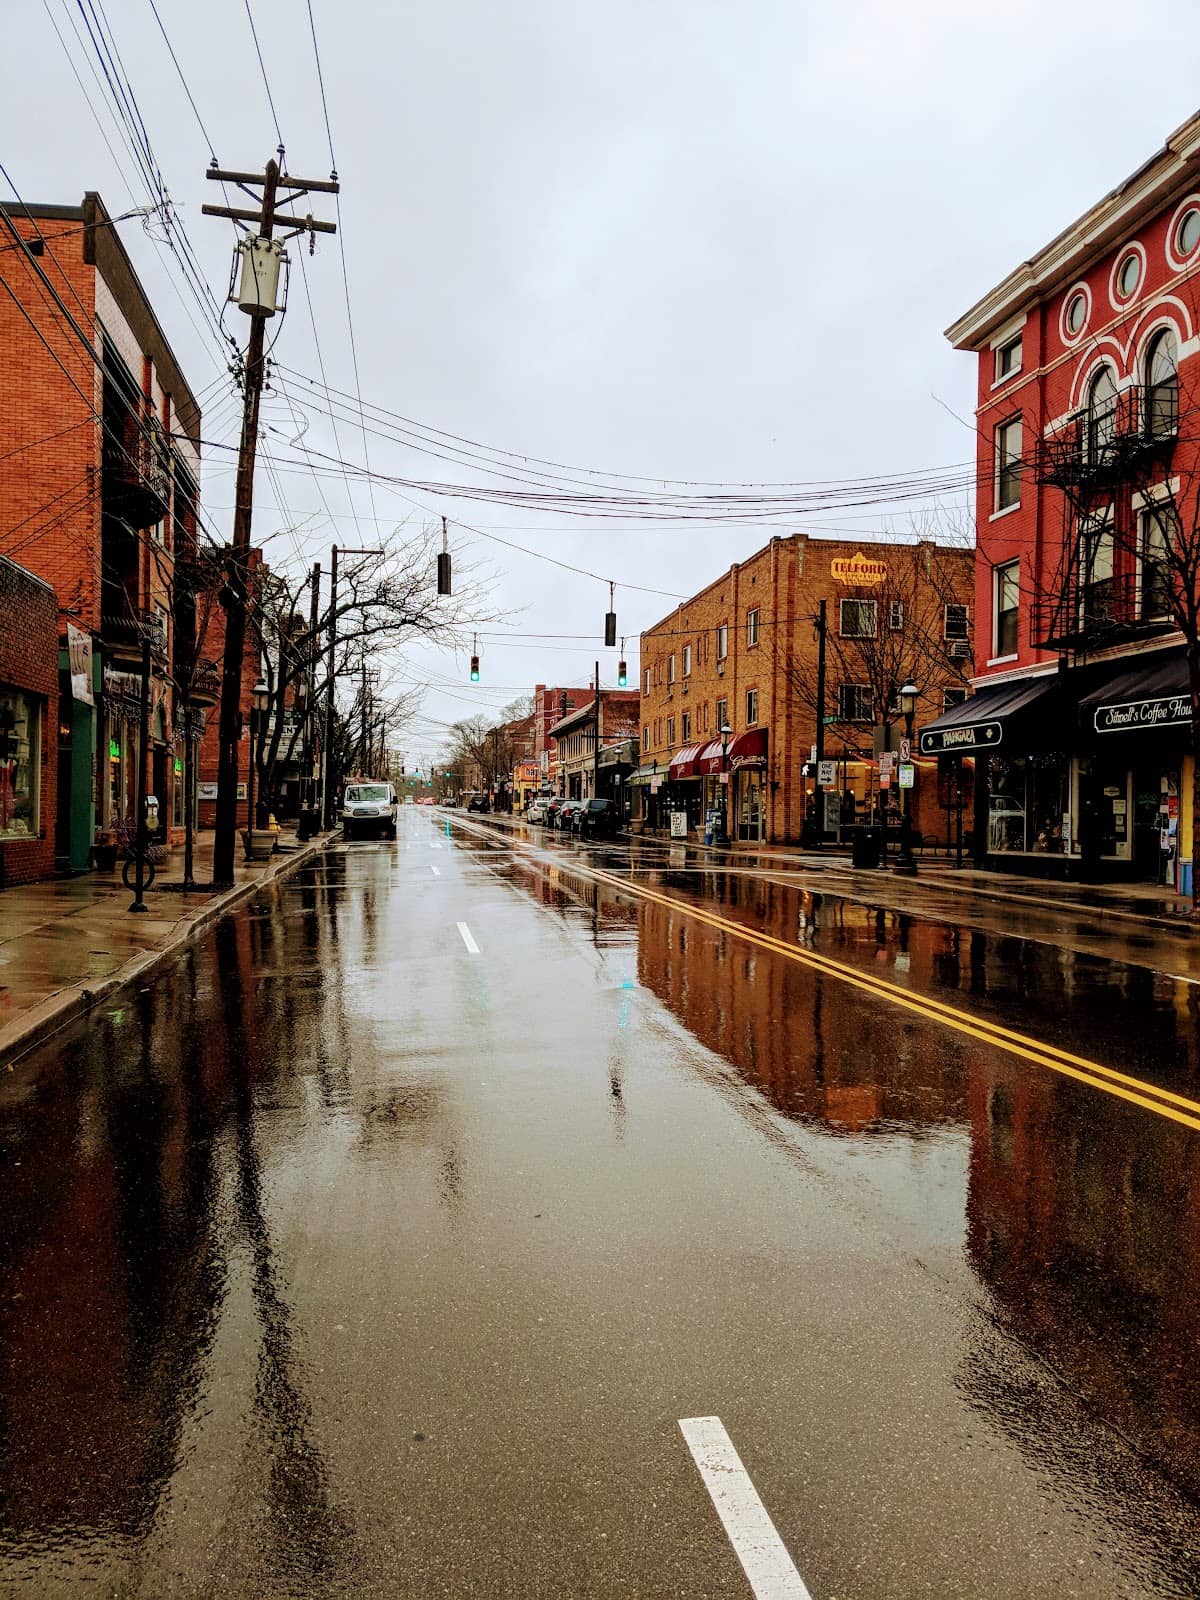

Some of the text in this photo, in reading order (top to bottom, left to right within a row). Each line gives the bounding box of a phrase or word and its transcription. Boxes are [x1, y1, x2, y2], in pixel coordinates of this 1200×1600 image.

[835, 562, 886, 574] TELFORD
[1105, 699, 1192, 725] Sitwell's Coffee Hou
